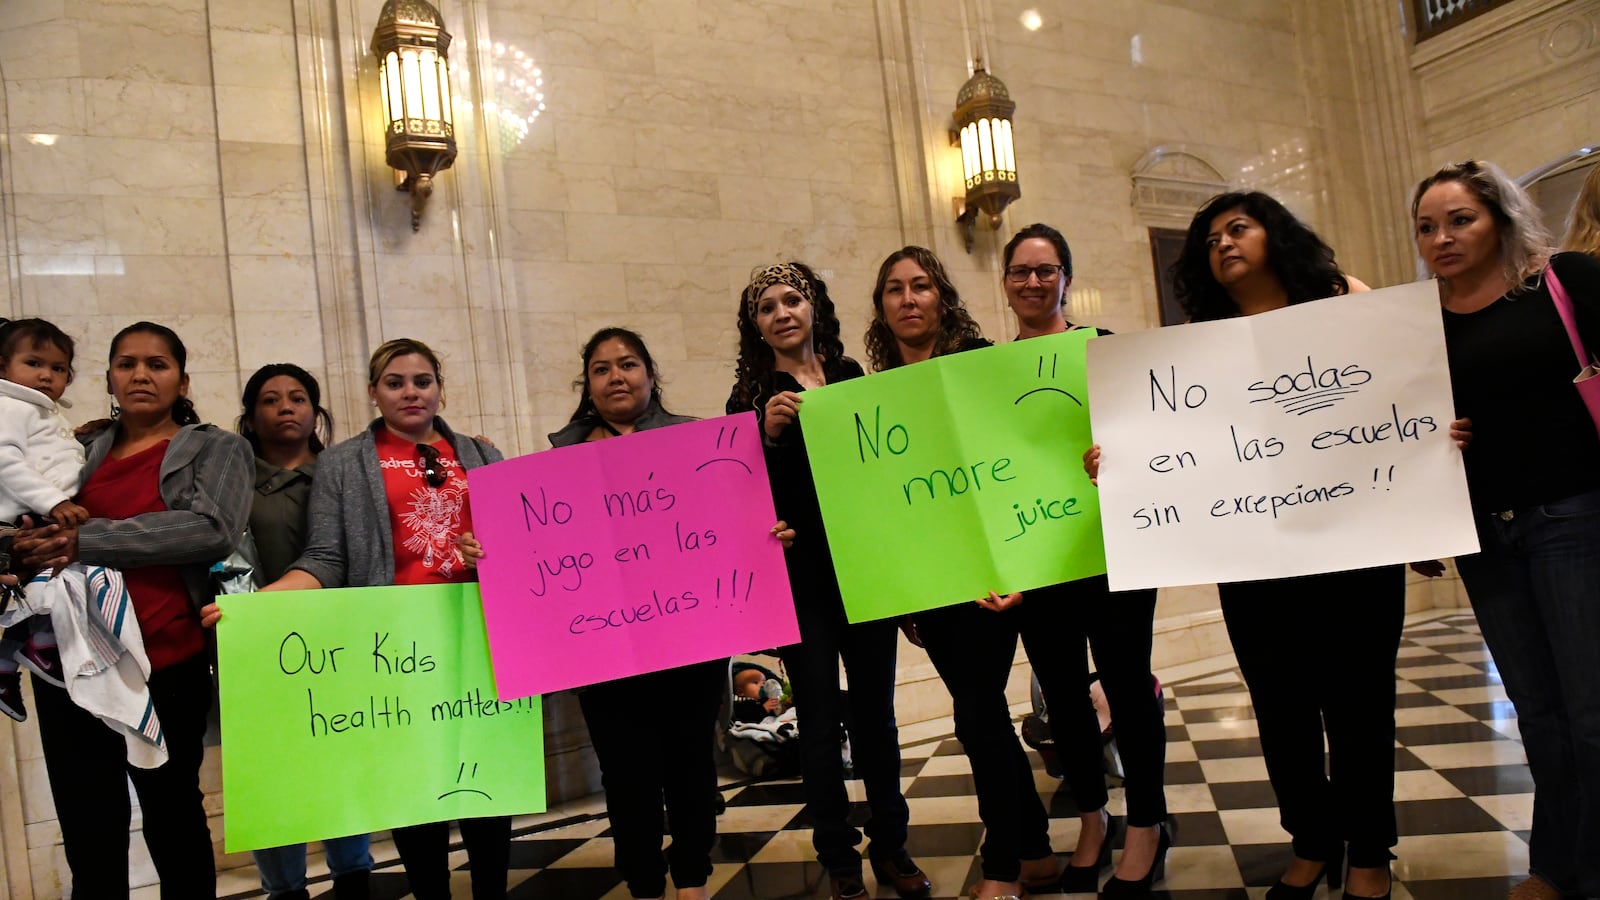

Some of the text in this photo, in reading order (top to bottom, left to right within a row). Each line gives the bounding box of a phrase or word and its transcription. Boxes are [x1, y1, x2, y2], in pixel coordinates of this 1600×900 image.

[1149, 356, 1371, 412] No sodas
[854, 405, 909, 464] No
[1149, 403, 1437, 473] en las escuelas
[379, 457, 416, 469] adres
[903, 458, 1016, 505] more
[520, 472, 675, 532] No más
[1005, 497, 1082, 542] juice
[1133, 502, 1180, 530] sin
[1210, 479, 1354, 518] excepciones
[530, 521, 717, 597] jugo en las
[569, 590, 699, 634] escuelas
[279, 631, 436, 675] Our Kids
[308, 688, 411, 737] health
